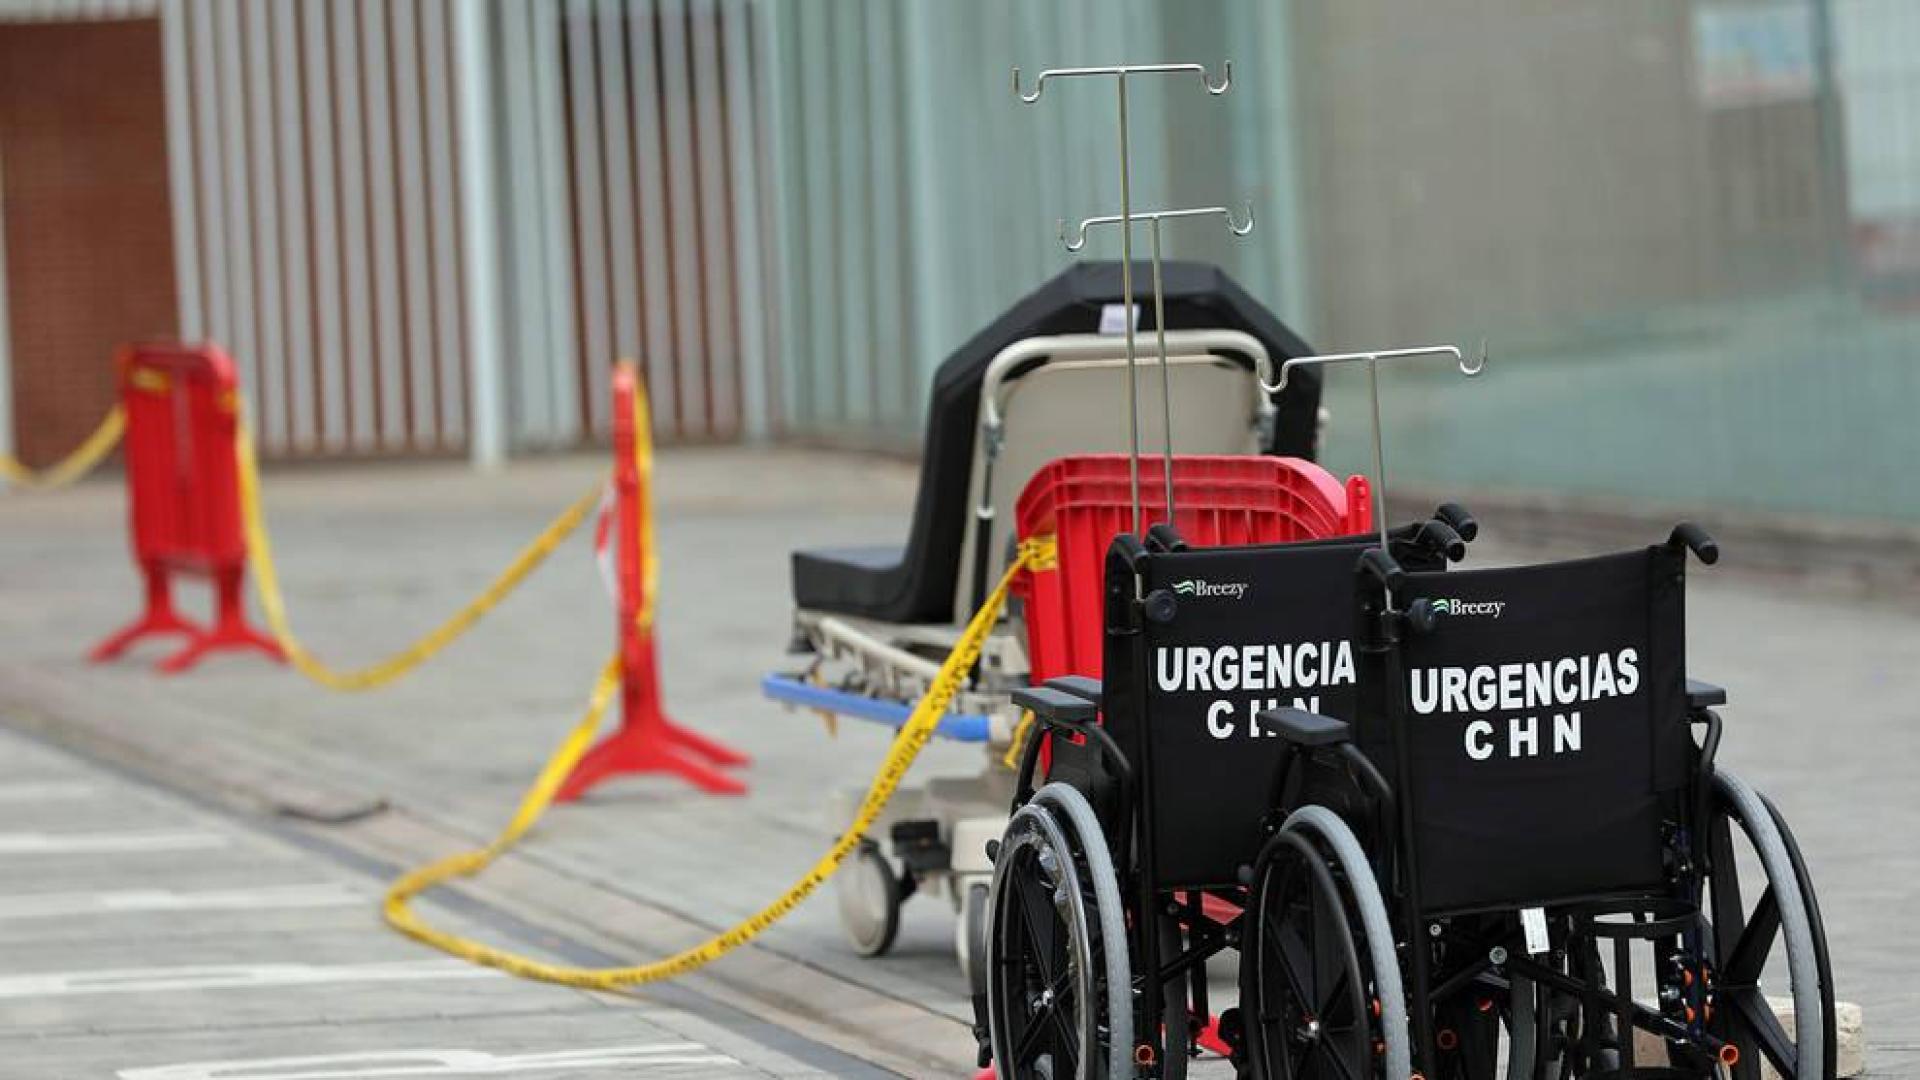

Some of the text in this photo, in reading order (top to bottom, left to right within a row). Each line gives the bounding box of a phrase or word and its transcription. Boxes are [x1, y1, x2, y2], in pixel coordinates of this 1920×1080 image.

[1196, 580, 1247, 599] Breezy
[1450, 599, 1505, 618] Breezy
[1158, 640, 1356, 691] URGENCIA
[1411, 648, 1640, 714] URGENCIAS
